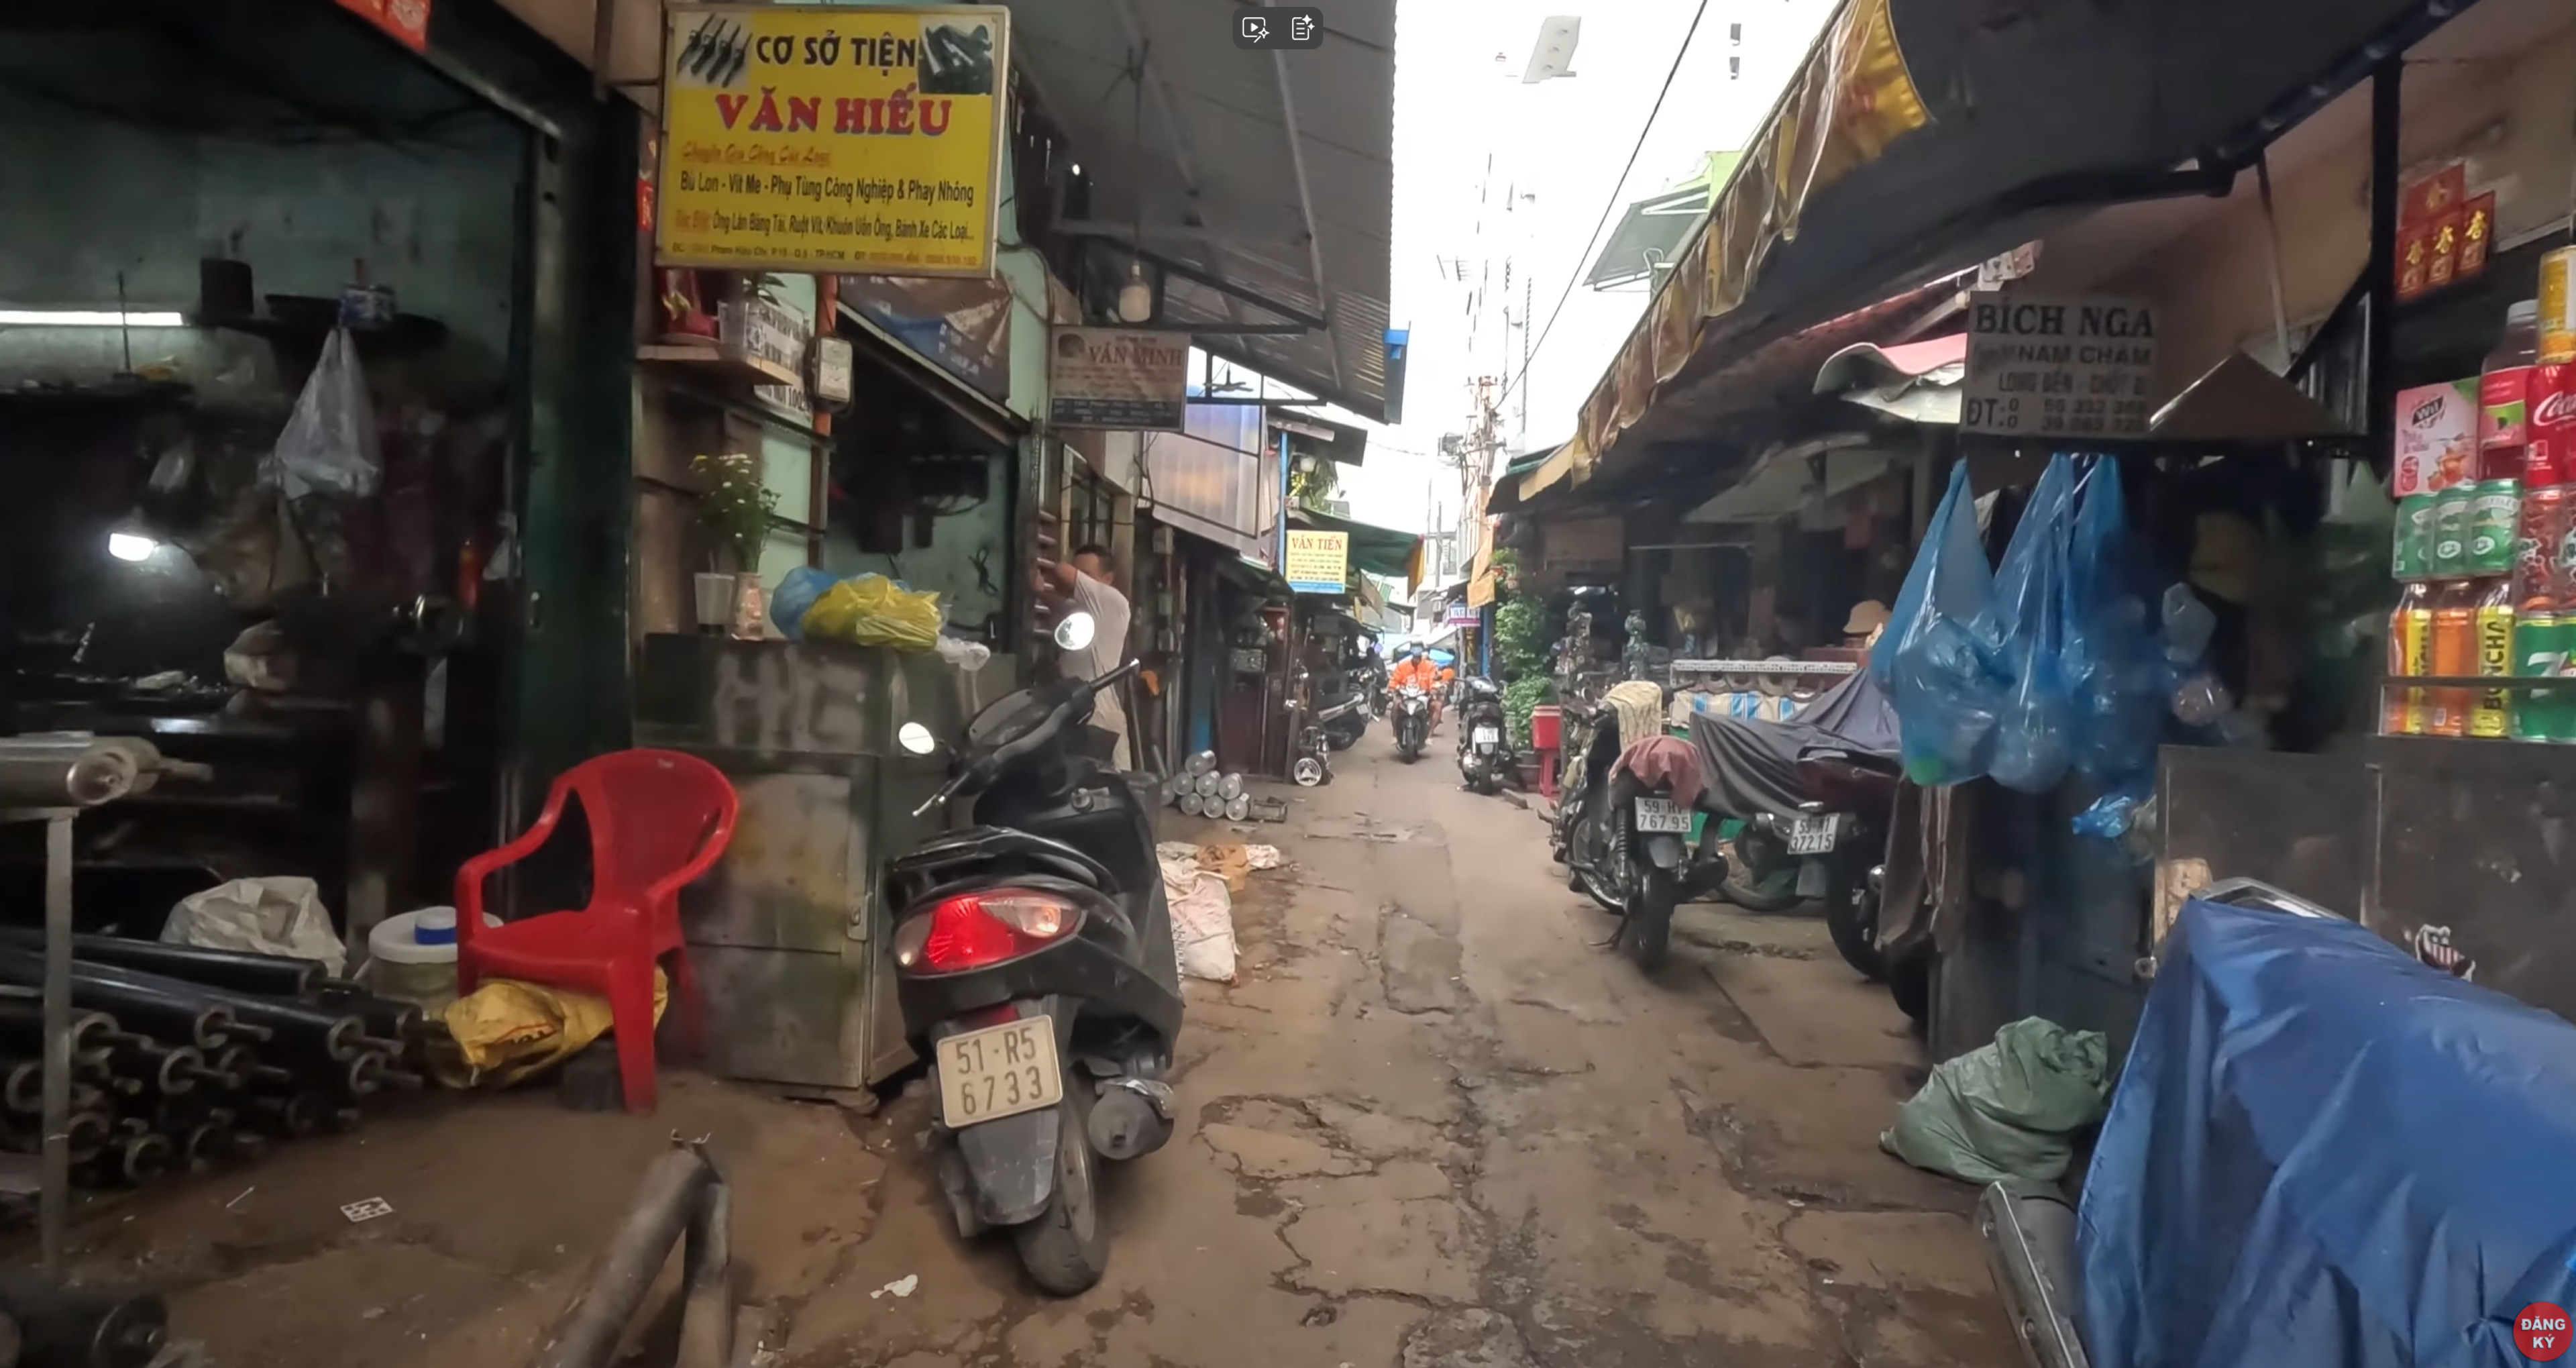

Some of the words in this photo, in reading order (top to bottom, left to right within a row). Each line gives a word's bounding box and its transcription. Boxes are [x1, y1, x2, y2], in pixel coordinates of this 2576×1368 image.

[757, 36, 795, 64] CƠ
[804, 30, 841, 66] SỞ
[851, 32, 916, 76] TIỆN
[716, 85, 821, 132] VĂN
[834, 83, 952, 136] HIẾU
[898, 178, 904, 199] &
[908, 179, 935, 206] Phay
[1974, 297, 2066, 335] BÍCH
[2078, 306, 2153, 337] NGA
[961, 1065, 1042, 1116] 6733
